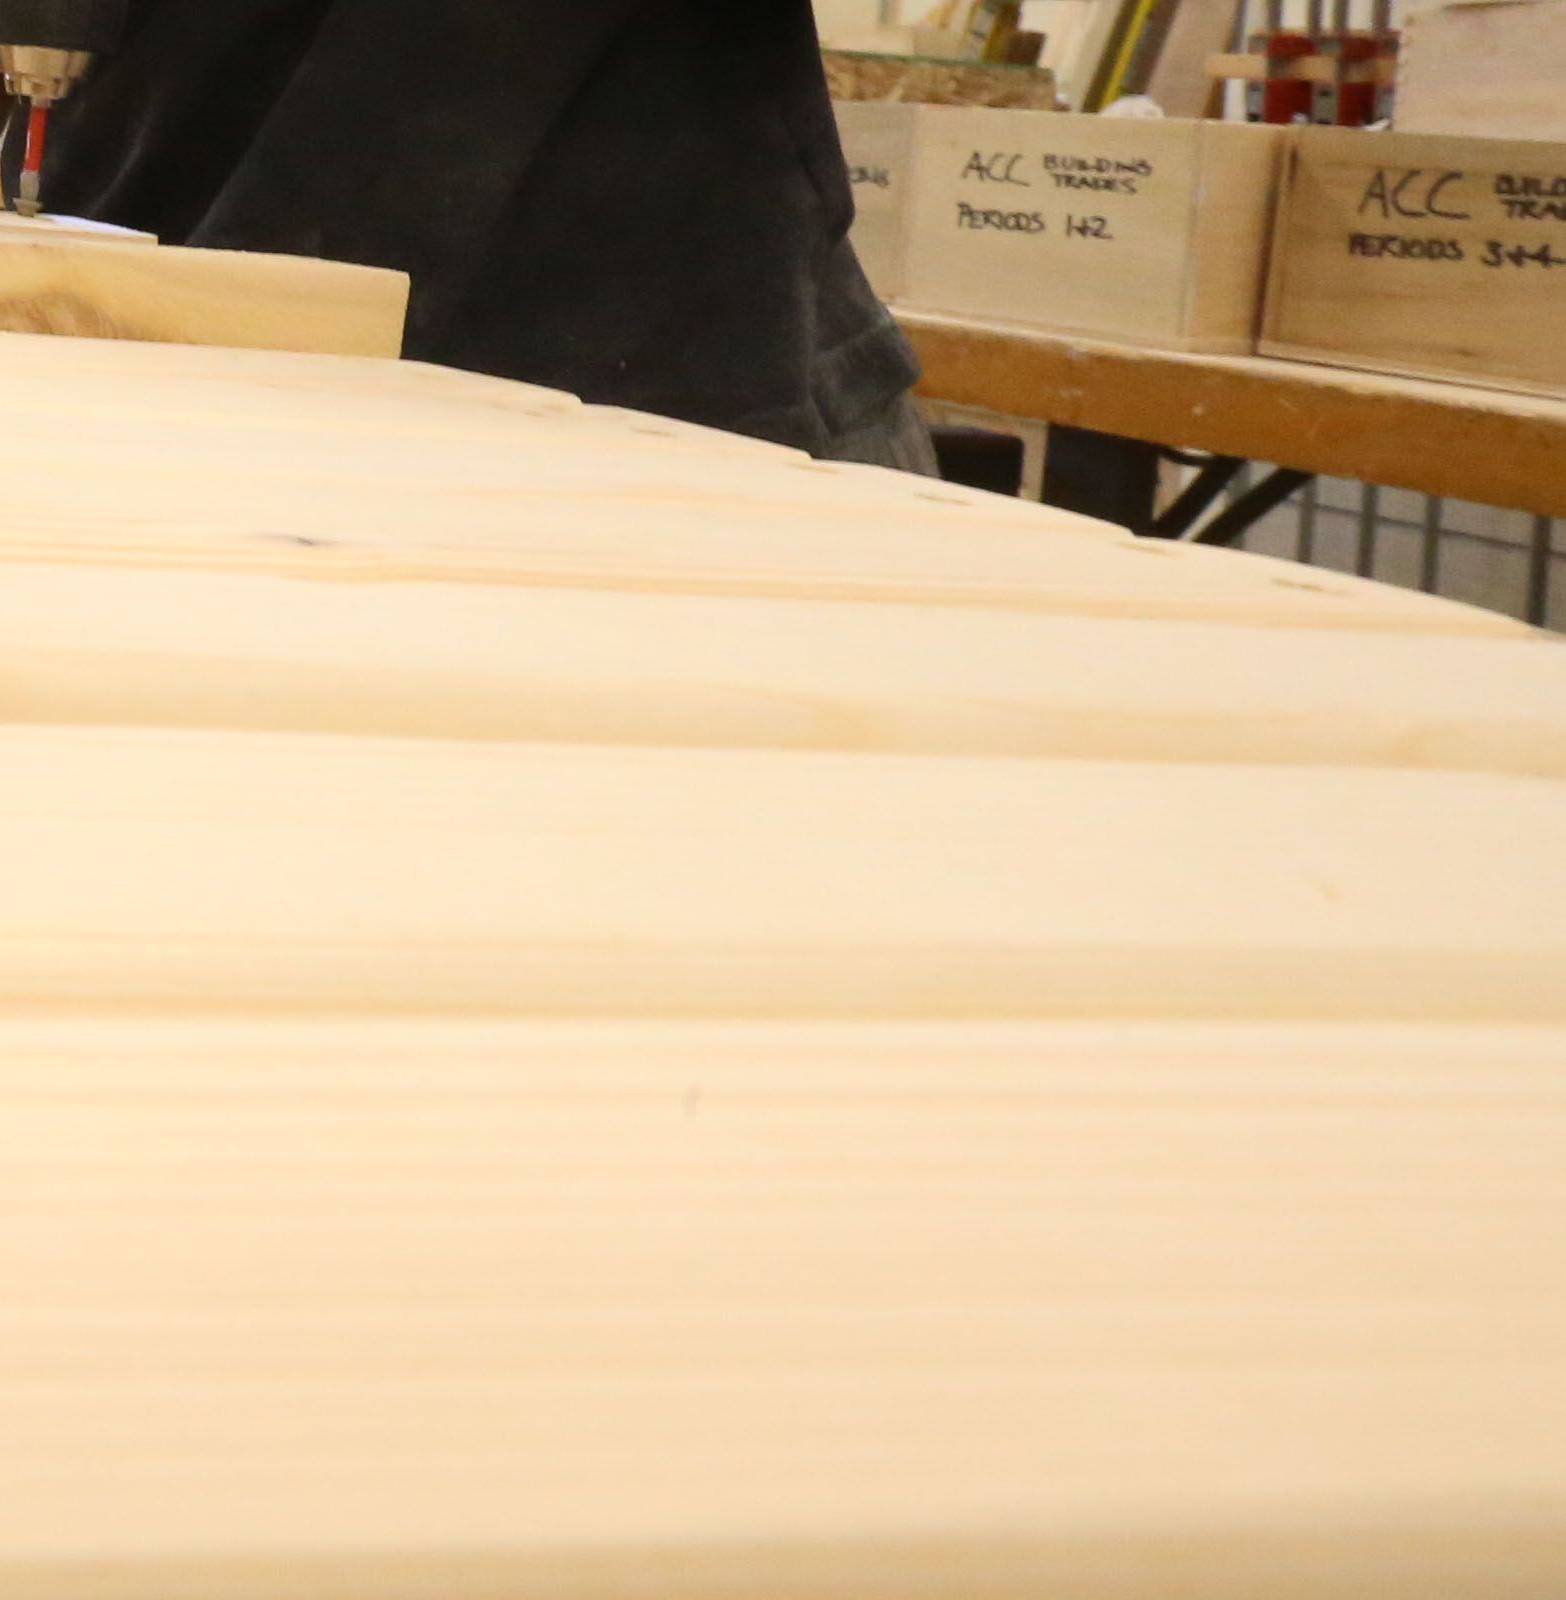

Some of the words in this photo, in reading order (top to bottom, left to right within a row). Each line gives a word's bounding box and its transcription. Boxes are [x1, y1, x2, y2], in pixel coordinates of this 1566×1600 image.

[962, 151, 1031, 188] ACC
[1043, 153, 1153, 177] BUILDING
[1052, 172, 1138, 195] TRADES
[1357, 169, 1472, 220] ACC
[956, 201, 1046, 235] PERIODS
[1349, 232, 1466, 260] PERIODS
